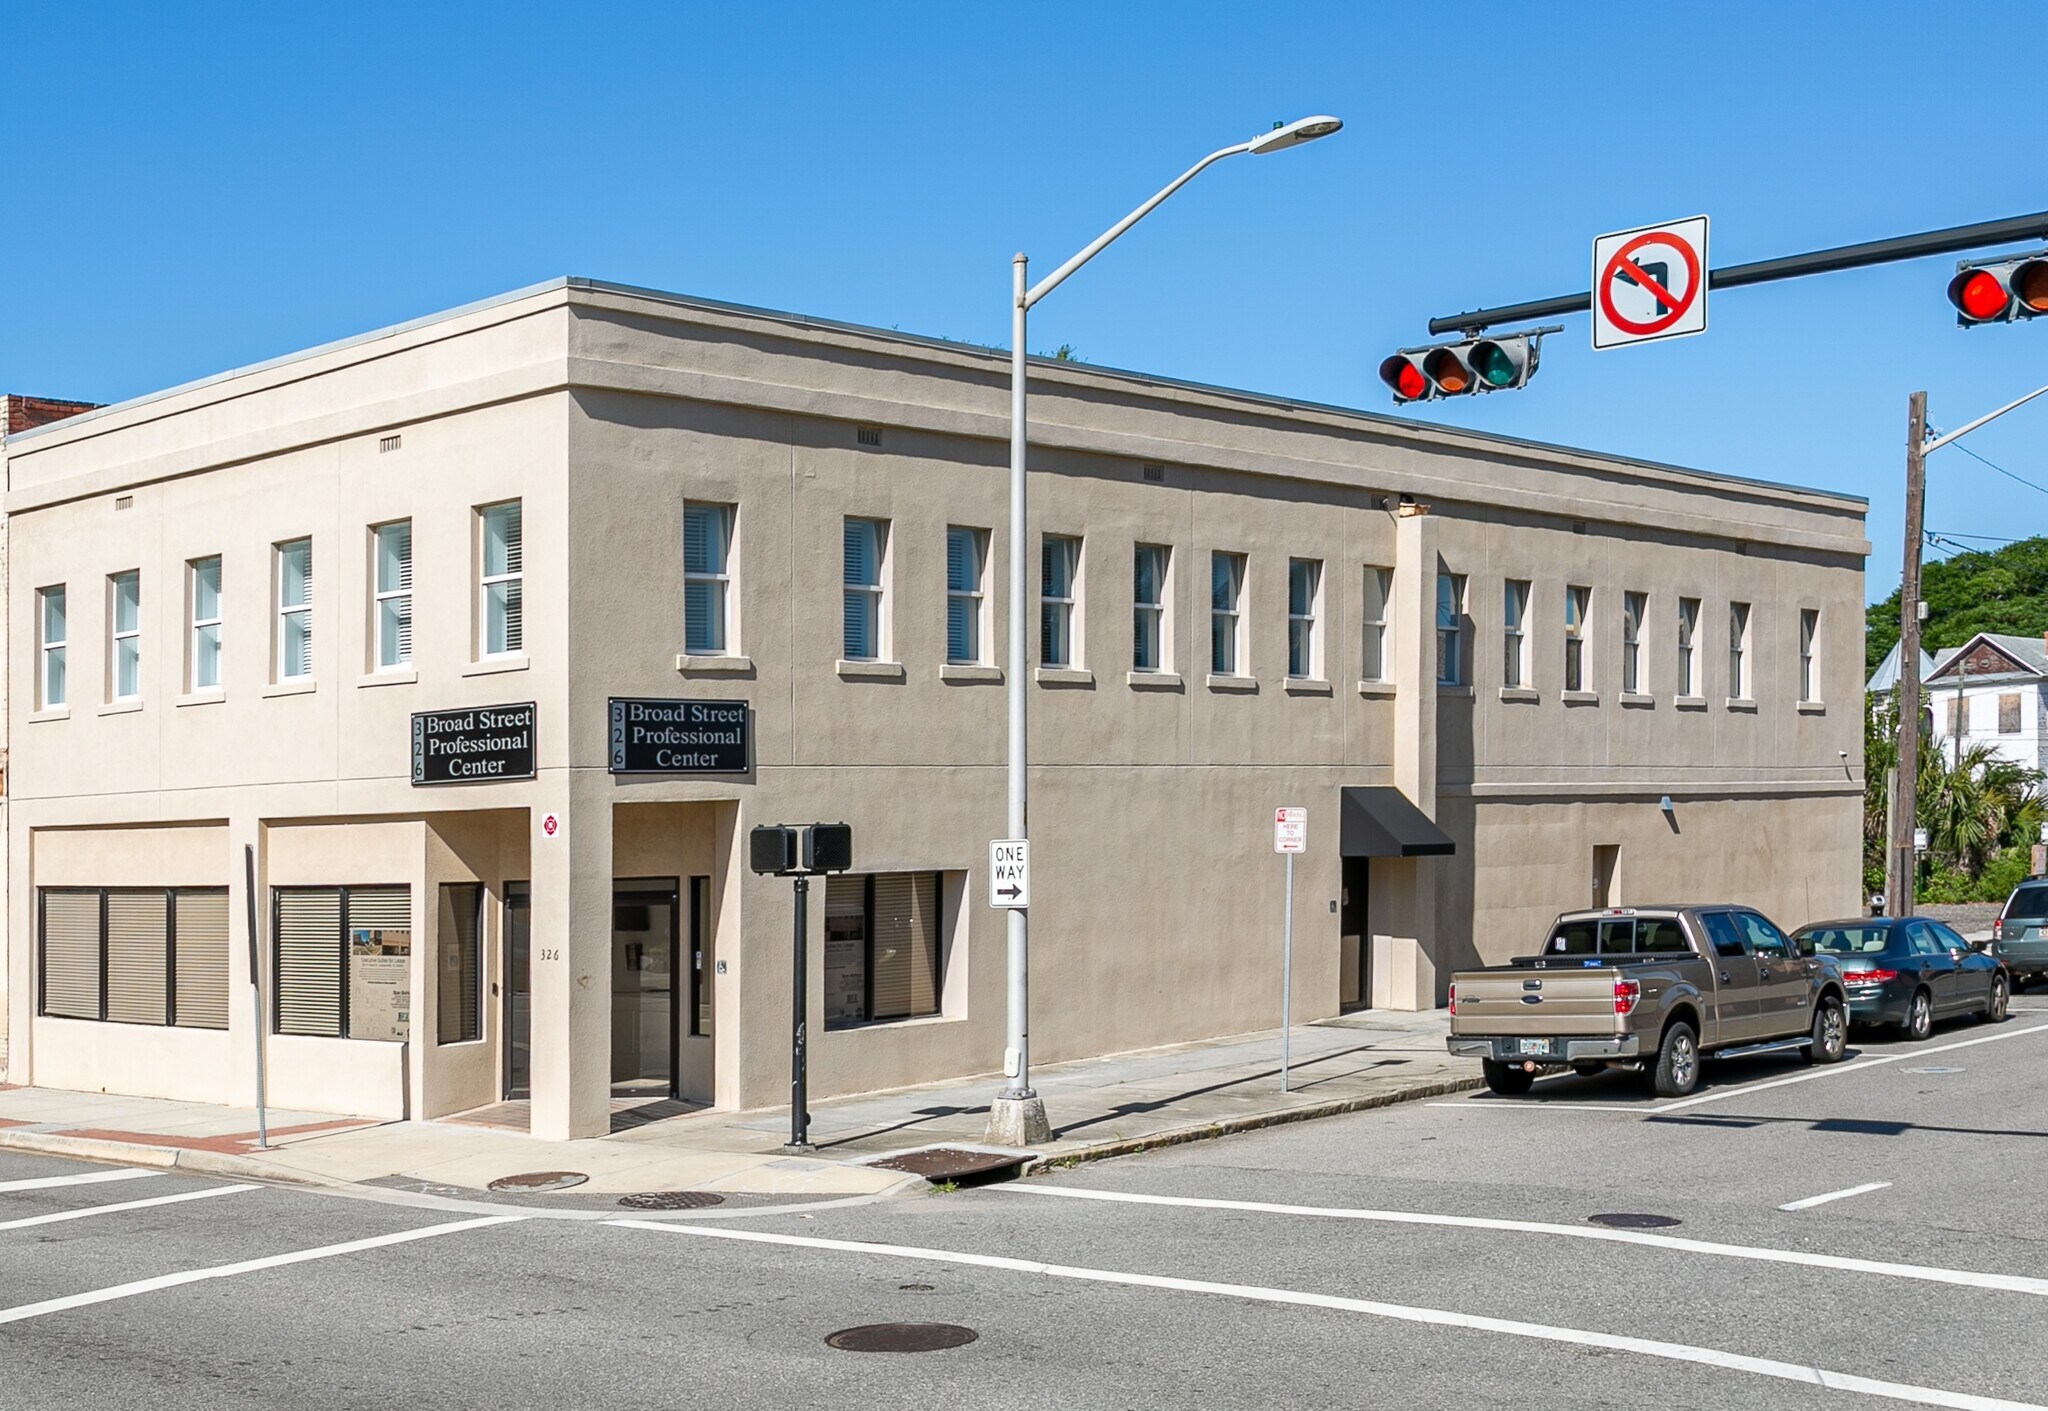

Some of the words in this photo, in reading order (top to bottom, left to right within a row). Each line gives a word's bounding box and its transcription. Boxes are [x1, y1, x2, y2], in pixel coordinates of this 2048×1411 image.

[426, 712, 475, 734] Broad
[479, 709, 532, 730] Street
[629, 703, 686, 721] Broad
[691, 705, 745, 722] Street
[429, 730, 528, 755] Professional
[632, 726, 742, 745] Professional
[448, 758, 506, 776] Center
[656, 749, 719, 767] Center
[995, 846, 1024, 862] ONE
[995, 865, 1025, 880] WAY
[541, 948, 559, 961] 326
